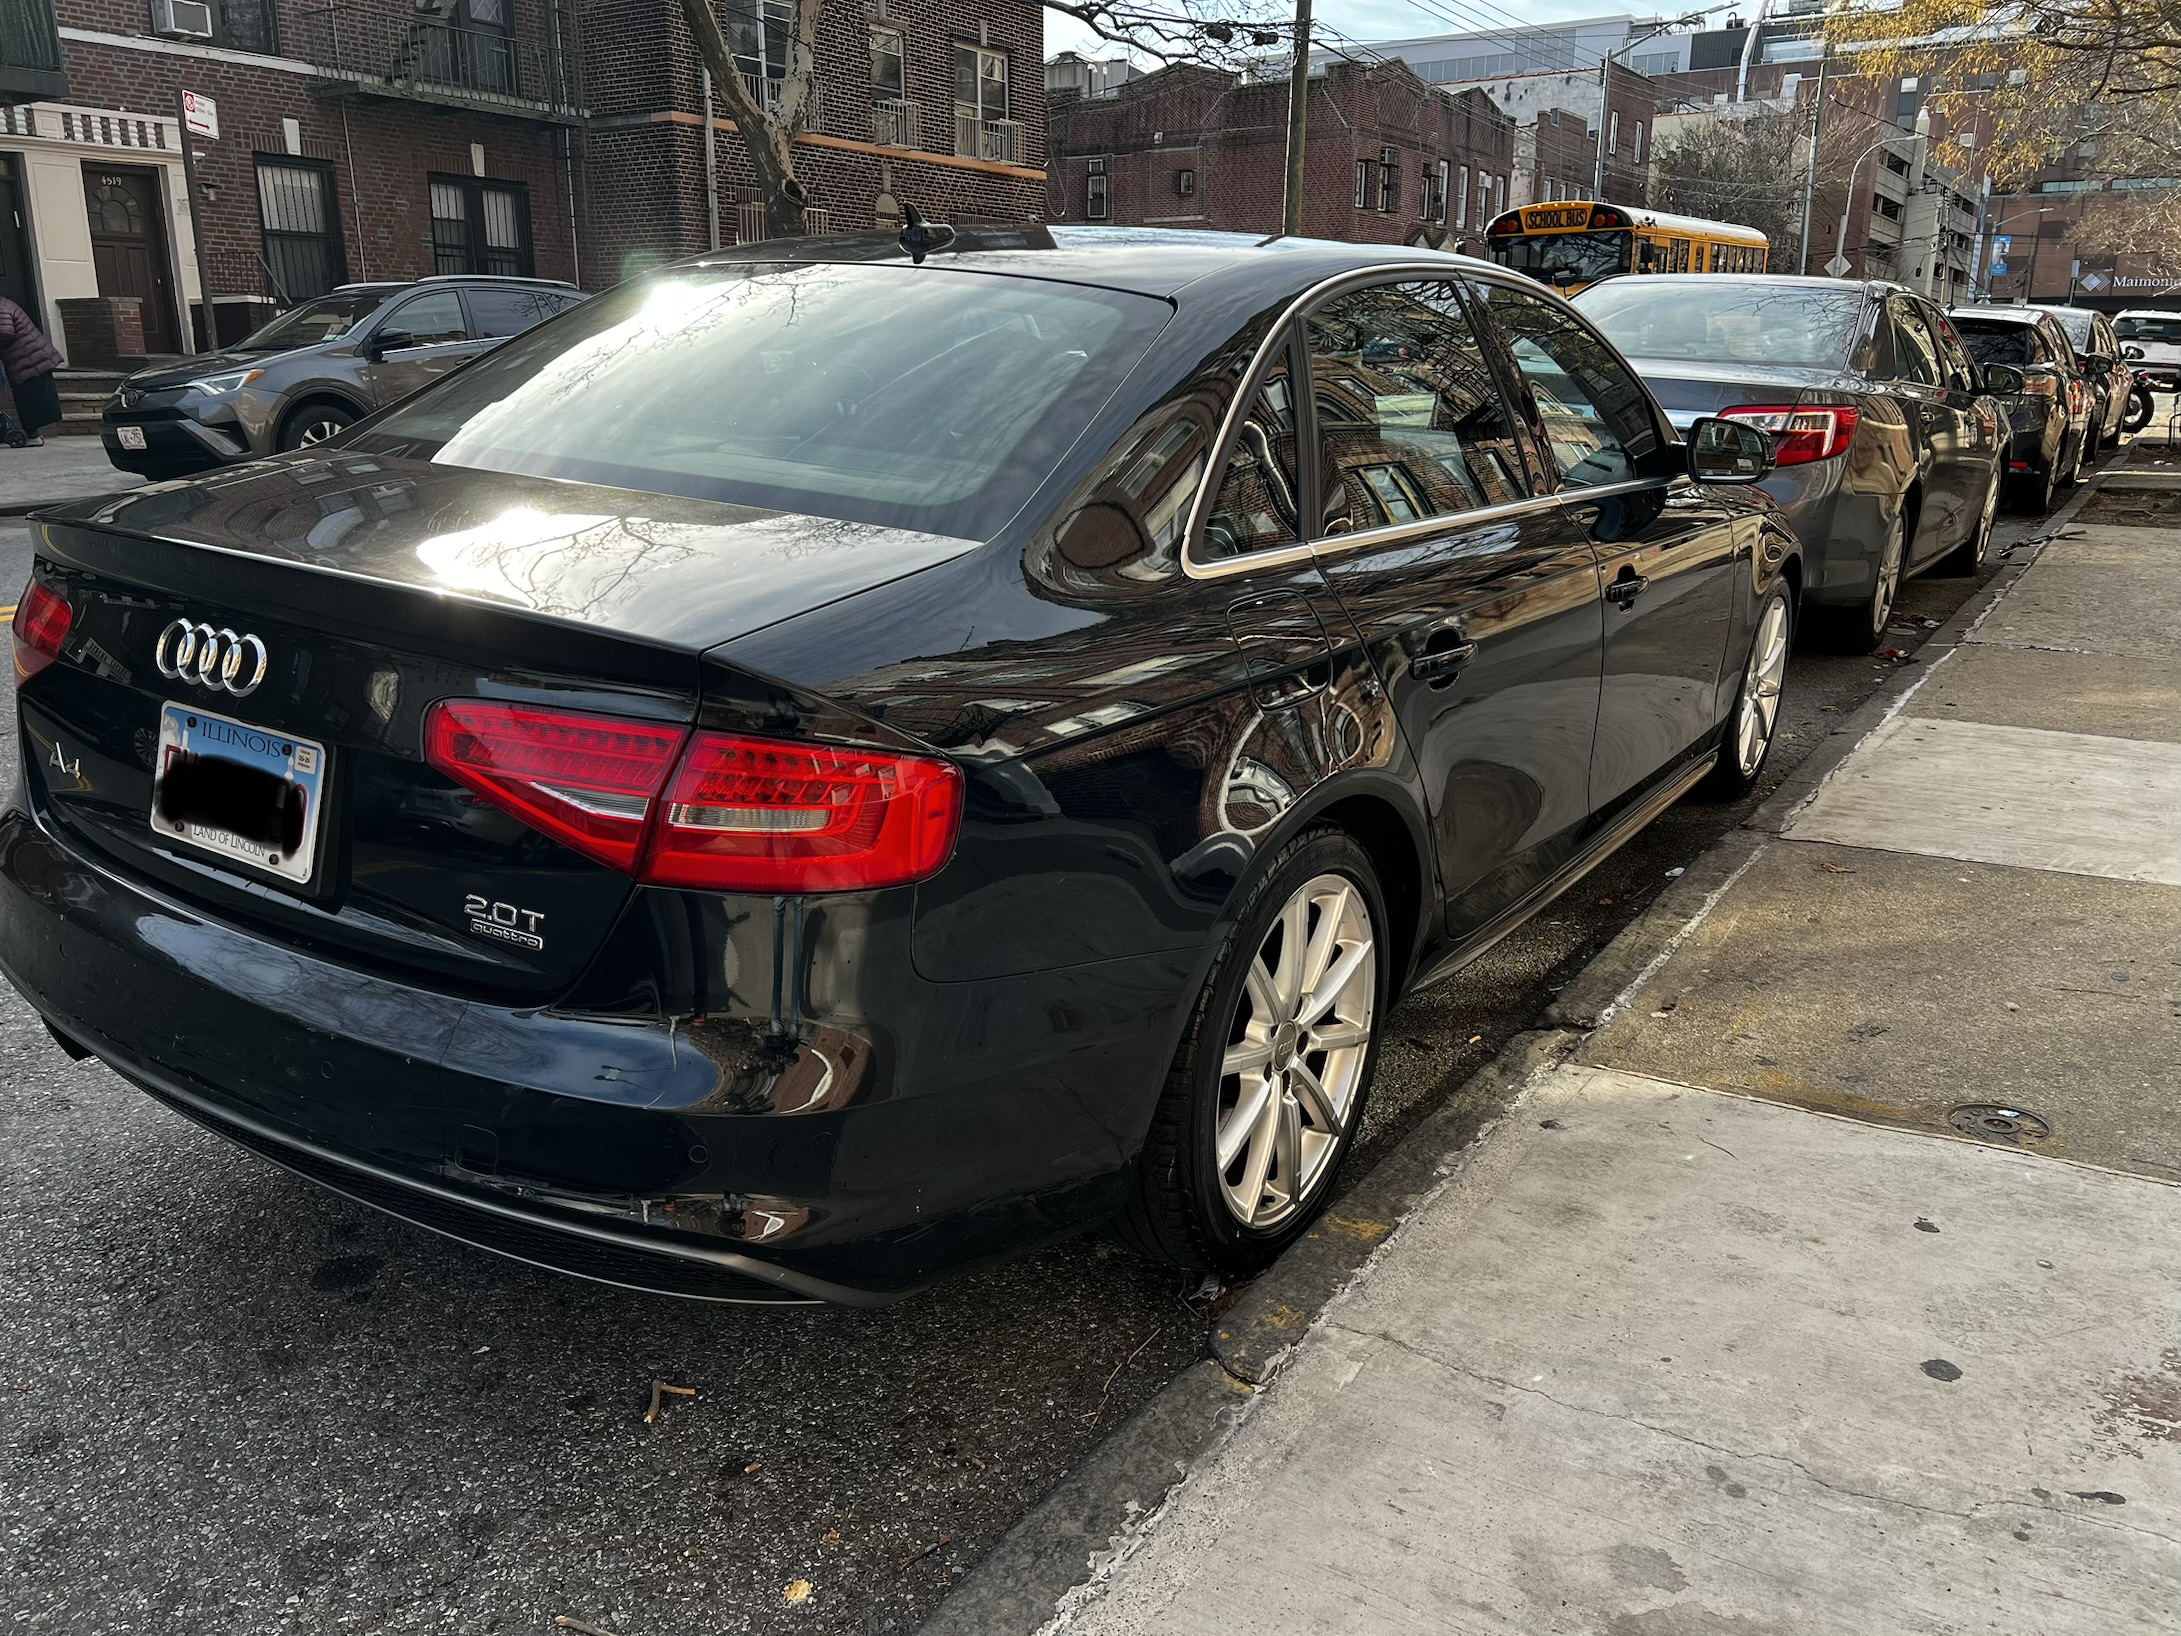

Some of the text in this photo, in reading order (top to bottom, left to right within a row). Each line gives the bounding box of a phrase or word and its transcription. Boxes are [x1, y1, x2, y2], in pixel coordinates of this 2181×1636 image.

[101, 176, 122, 186] 4519
[1528, 209, 1585, 228] SCHOOL BUS
[202, 721, 282, 758] ILLINOIS
[49, 741, 81, 779] A4
[193, 823, 266, 858] LAND OF LINCOLN
[464, 893, 545, 933] 2.0T
[473, 922, 539, 947] quattro
